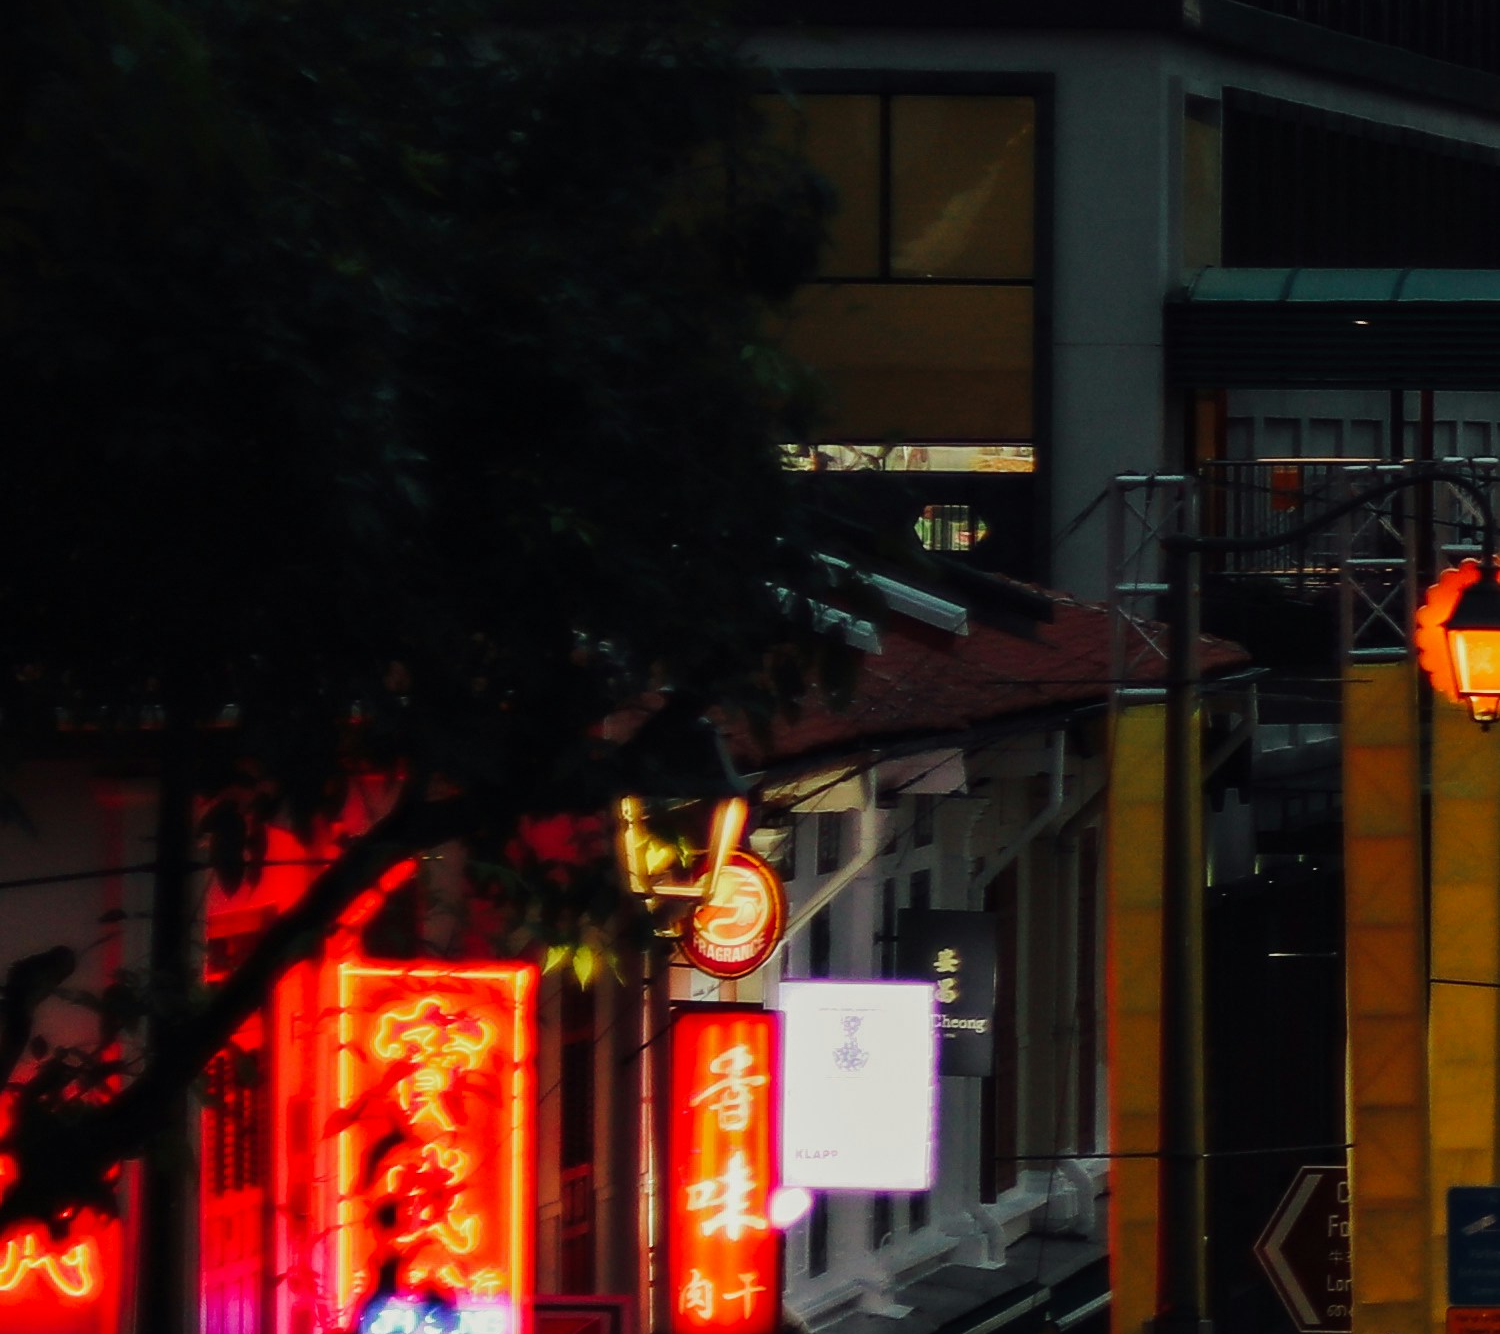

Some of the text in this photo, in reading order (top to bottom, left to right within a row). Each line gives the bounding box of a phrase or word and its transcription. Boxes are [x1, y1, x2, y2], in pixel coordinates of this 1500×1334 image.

[693, 931, 766, 963] FRAGRANCE
[932, 1013, 988, 1035] Cheong
[689, 1042, 769, 1242] 香味
[678, 1268, 767, 1321] 肉干
